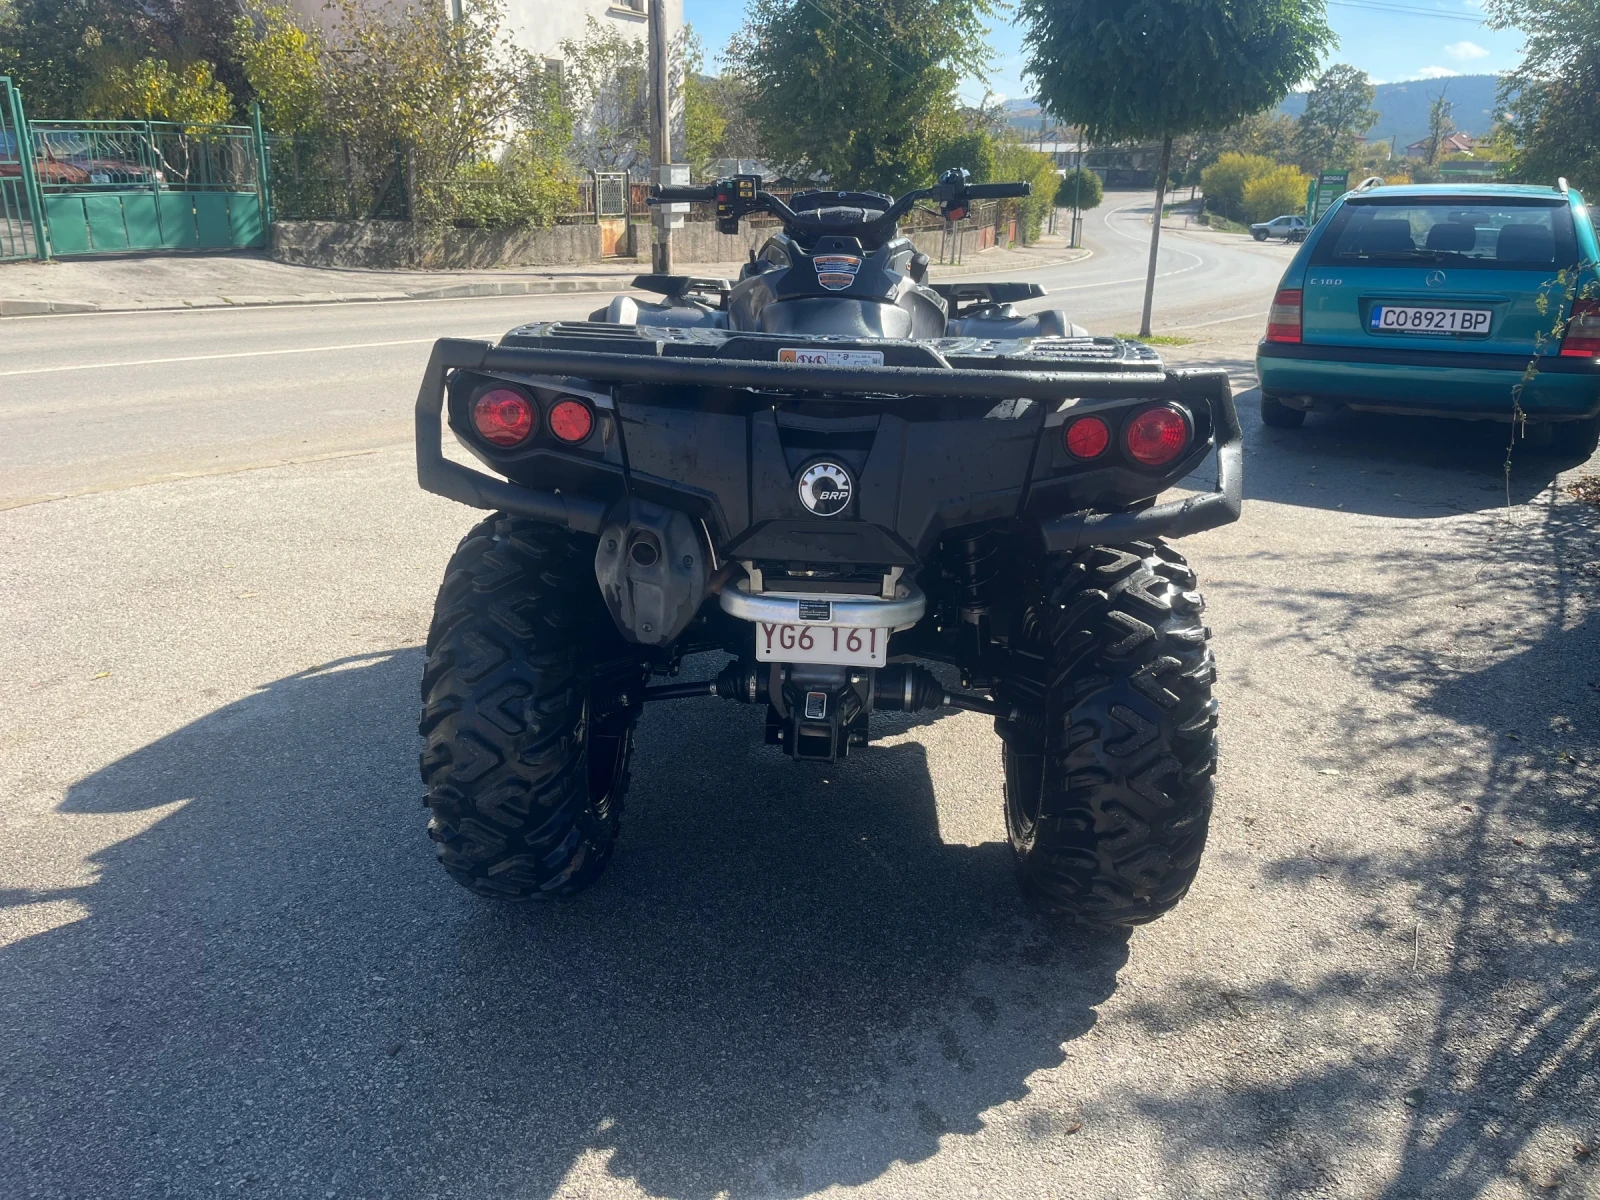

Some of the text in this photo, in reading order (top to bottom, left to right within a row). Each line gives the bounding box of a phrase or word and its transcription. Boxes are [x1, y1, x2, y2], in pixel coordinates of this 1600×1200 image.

[1411, 311, 1456, 328] 8921
[1460, 313, 1487, 330] BP
[819, 491, 849, 500] BRP
[761, 623, 876, 653] YG6 161
